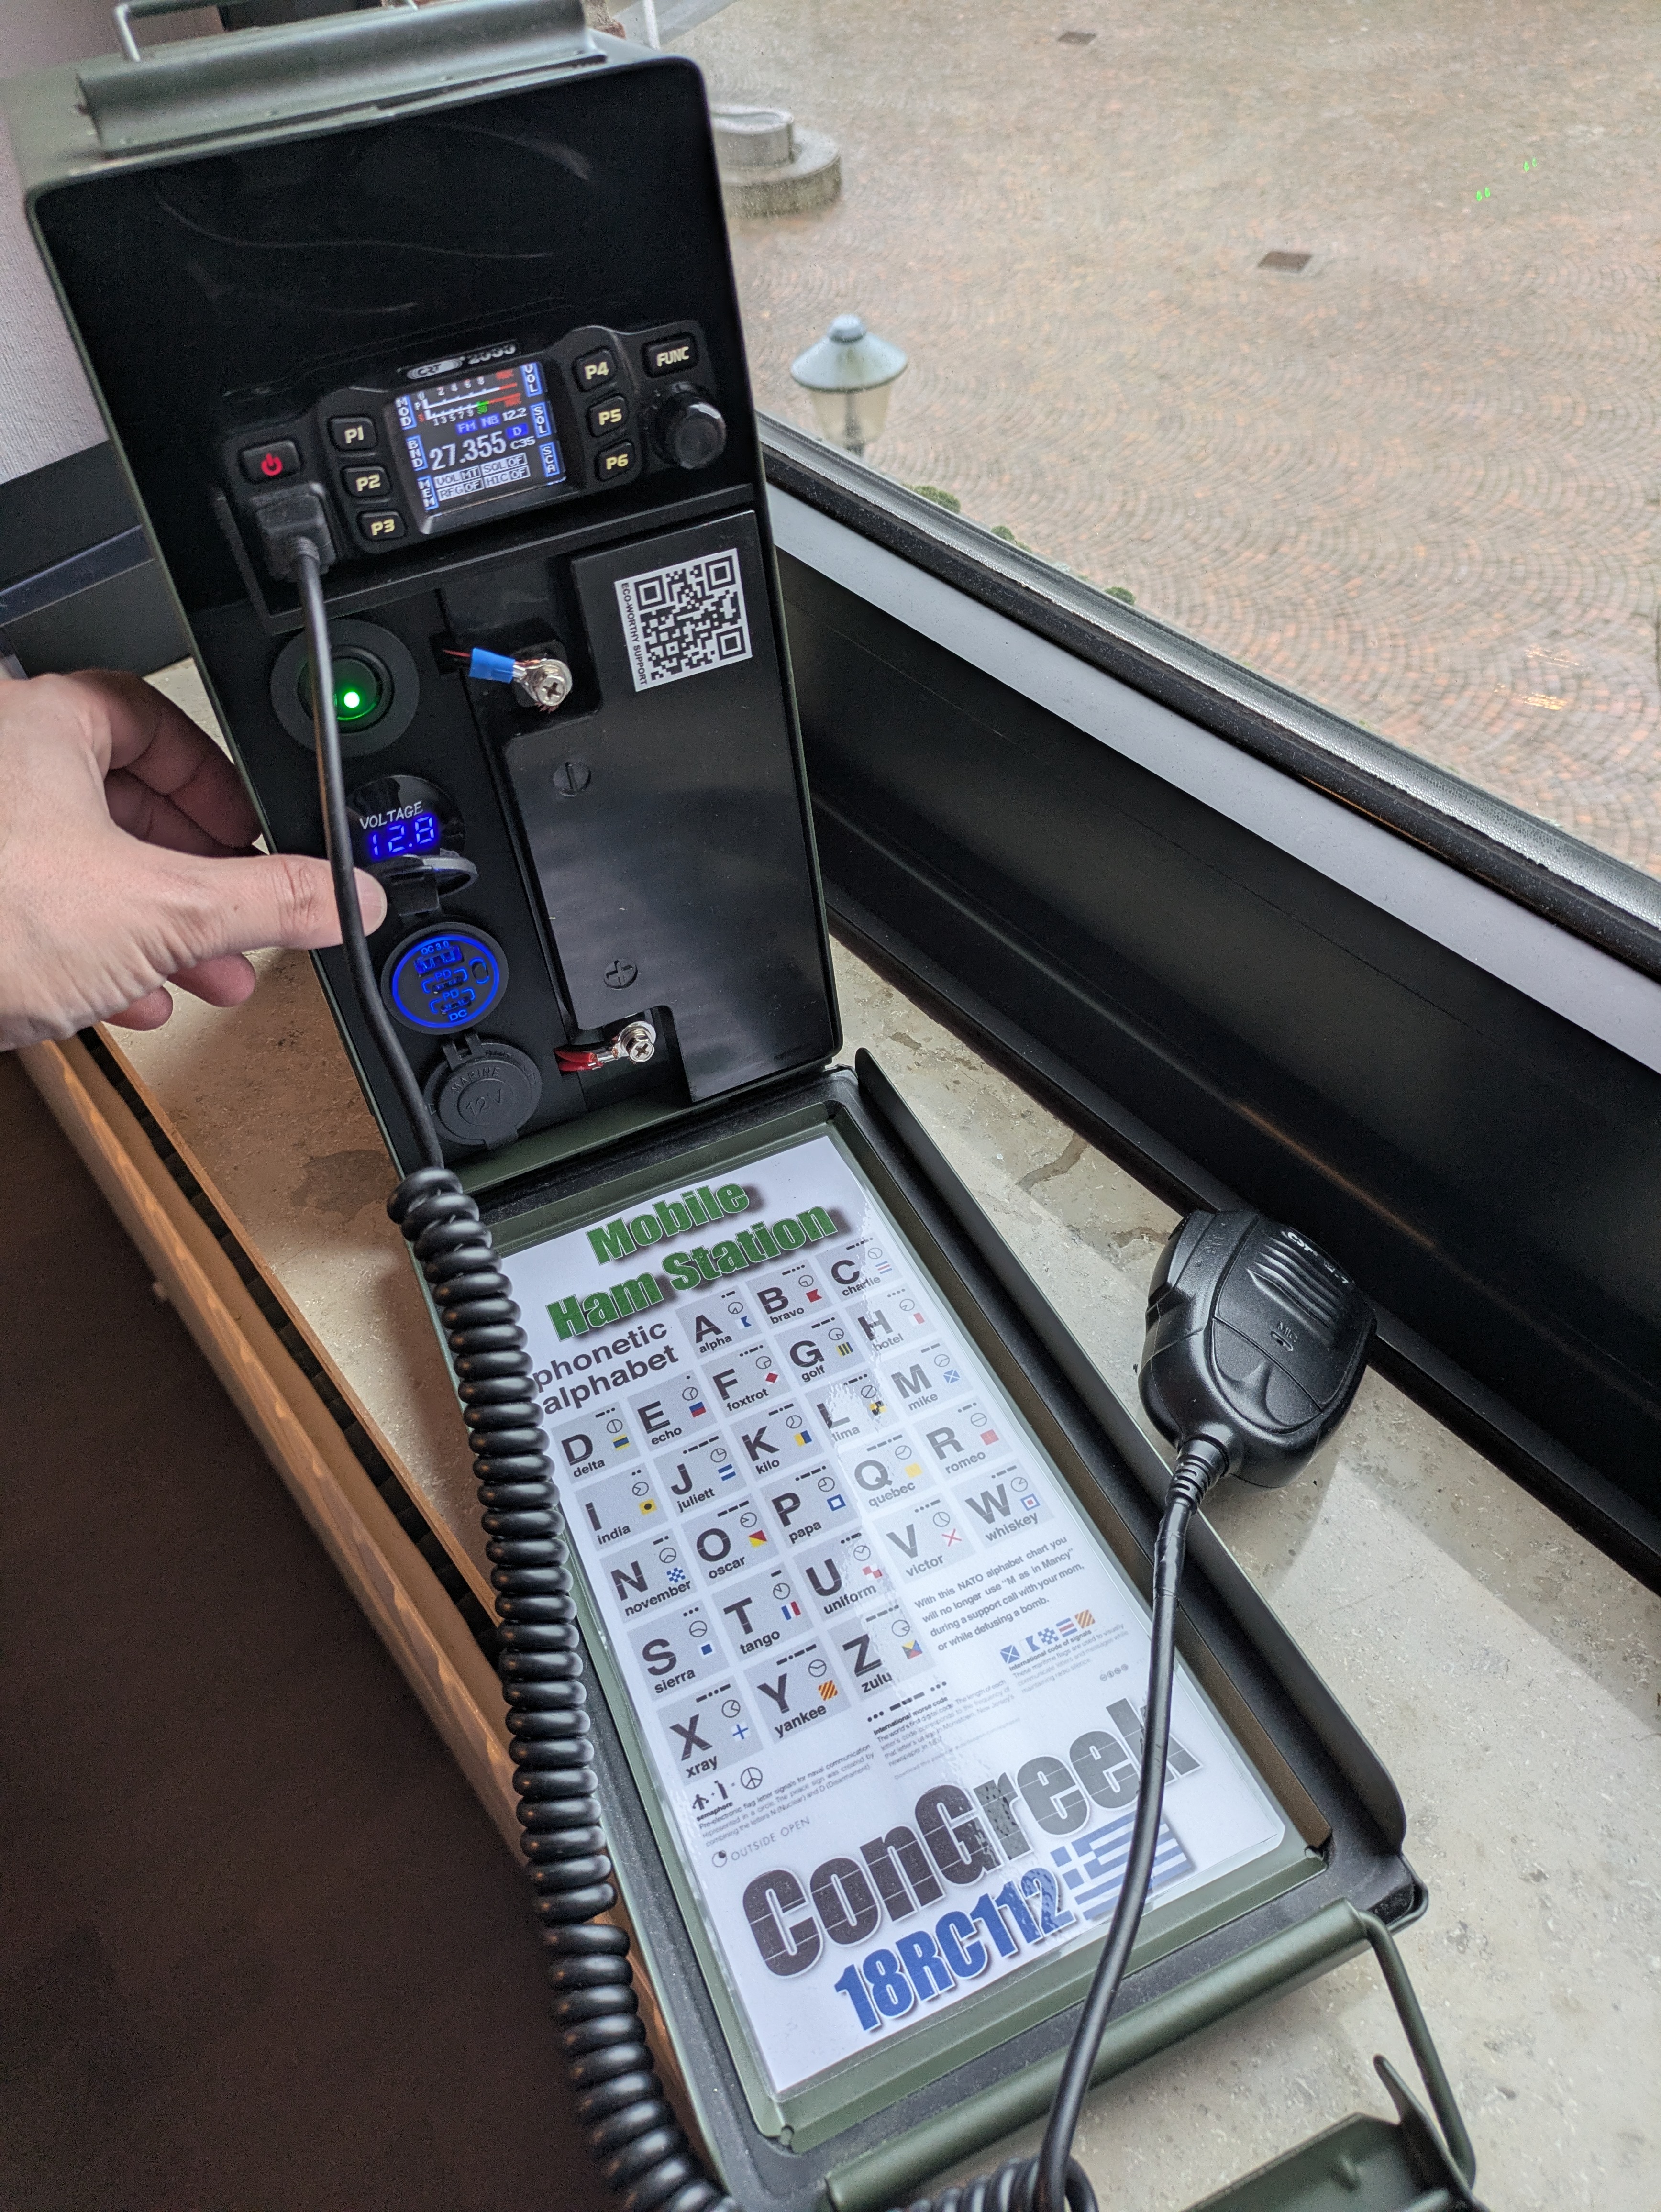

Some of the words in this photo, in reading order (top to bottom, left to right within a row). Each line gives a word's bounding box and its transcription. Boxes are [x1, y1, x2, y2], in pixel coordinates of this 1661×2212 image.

[656, 346, 689, 367] FUNC
[584, 362, 609, 380] P4
[396, 398, 411, 426] MOD
[458, 422, 476, 433] FM
[482, 416, 499, 427] NB
[598, 408, 622, 425] P5
[344, 425, 364, 444] P1
[510, 436, 535, 449] C35
[512, 427, 522, 436] D
[407, 440, 423, 467] BND
[430, 431, 506, 470] 27.355
[543, 446, 556, 473] SCA
[606, 453, 628, 470] P6
[462, 468, 478, 480] MT
[508, 455, 523, 466] OF
[356, 474, 381, 492] P2
[419, 480, 435, 507] MEM
[440, 487, 463, 498] RFG
[465, 481, 479, 492] OF
[486, 474, 508, 485] HIC
[511, 468, 525, 479] OF
[371, 518, 395, 536] P3
[621, 583, 640, 643] ECO-WORTHY
[633, 644, 647, 685] SUPPORT
[360, 801, 423, 830] VOLTAGE
[372, 816, 434, 856] 12.8
[435, 940, 449, 950] 3.0
[434, 969, 452, 981] PD
[442, 989, 459, 1001] PD
[449, 1009, 467, 1021] DC
[451, 1067, 500, 1093] MARINE
[586, 1183, 749, 1266] Mobile
[546, 1272, 664, 1342] Ham
[662, 1205, 838, 1292] Station
[831, 1260, 860, 1285] C
[842, 1277, 880, 1296] charlie
[757, 1287, 788, 1315] B
[696, 1315, 723, 1343] A
[770, 1308, 804, 1324] bravo
[857, 1310, 893, 1341] H
[532, 1322, 668, 1388] phonetic
[699, 1336, 732, 1353] alpha
[790, 1340, 825, 1367] G
[870, 1333, 904, 1352] hotel
[543, 1345, 679, 1415] alphabet
[712, 1369, 738, 1401] F
[802, 1365, 825, 1382] golf
[891, 1364, 932, 1399] M
[727, 1389, 769, 1411] foxtrot
[908, 1394, 938, 1411] mike
[637, 1401, 670, 1434] E
[817, 1403, 850, 1429] L
[652, 1427, 682, 1445] echo
[742, 1426, 780, 1461] K
[830, 1427, 860, 1441] lima
[926, 1427, 965, 1460] R
[561, 1434, 593, 1466] D
[945, 1452, 986, 1474] romeo
[574, 1460, 605, 1477] delta
[671, 1463, 692, 1495] J
[755, 1460, 780, 1474] kilo
[854, 1460, 893, 1491] Q
[677, 1488, 715, 1513] juliett
[869, 1482, 915, 1507] quebec
[964, 1483, 1011, 1524] W
[585, 1502, 602, 1531] I
[771, 1493, 801, 1527] P
[597, 1526, 631, 1545] india
[789, 1522, 821, 1544] papa
[986, 1513, 1038, 1541] whiskey
[697, 1528, 731, 1562] O
[886, 1524, 918, 1559] V
[709, 1557, 745, 1579] oscar
[806, 1558, 842, 1596] U
[906, 1555, 943, 1576] victor
[914, 1596, 936, 1608] With
[938, 1588, 955, 1599] this
[957, 1574, 983, 1590] NATO
[986, 1556, 1024, 1578] alphabet
[1026, 1544, 1049, 1559] chart
[1050, 1537, 1067, 1550] you
[611, 1560, 648, 1601] N
[922, 1611, 939, 1622] will
[940, 1607, 952, 1615] no
[953, 1593, 981, 1609] longer
[985, 1584, 1002, 1595] use
[1002, 1575, 1016, 1585] “M
[1019, 1571, 1030, 1580] as
[1041, 1548, 1073, 1569] Mancy”
[625, 1581, 690, 1616] november
[824, 1586, 876, 1614] uniform
[930, 1620, 961, 1637] during
[967, 1600, 1002, 1620] support
[1003, 1592, 1018, 1604] call
[1018, 1584, 1038, 1596] with
[1037, 1574, 1057, 1590] your
[1058, 1564, 1084, 1578] mom,
[723, 1597, 753, 1635] T
[938, 1642, 947, 1650] or
[949, 1632, 973, 1646] while
[974, 1614, 1013, 1635] defusing
[1019, 1597, 1049, 1613] bomb.
[740, 1631, 780, 1654] tango
[842, 1634, 882, 1677] Z
[1009, 1650, 1046, 1671] international
[1047, 1644, 1062, 1653] code
[1070, 1630, 1092, 1642] signals
[642, 1639, 677, 1676] S
[655, 1670, 696, 1693] sierra
[757, 1673, 790, 1714] Y
[862, 1672, 893, 1693] zulu
[775, 1705, 826, 1738] yankee
[669, 1714, 712, 1761] X
[686, 1756, 717, 1778] xray
[697, 1802, 733, 1822] semaphore
[731, 1833, 776, 1861] OUTSIDE
[781, 1816, 810, 1836] OPEN
[742, 1698, 1203, 1979] ConGreek
[834, 1868, 1076, 2033] 18RC112
